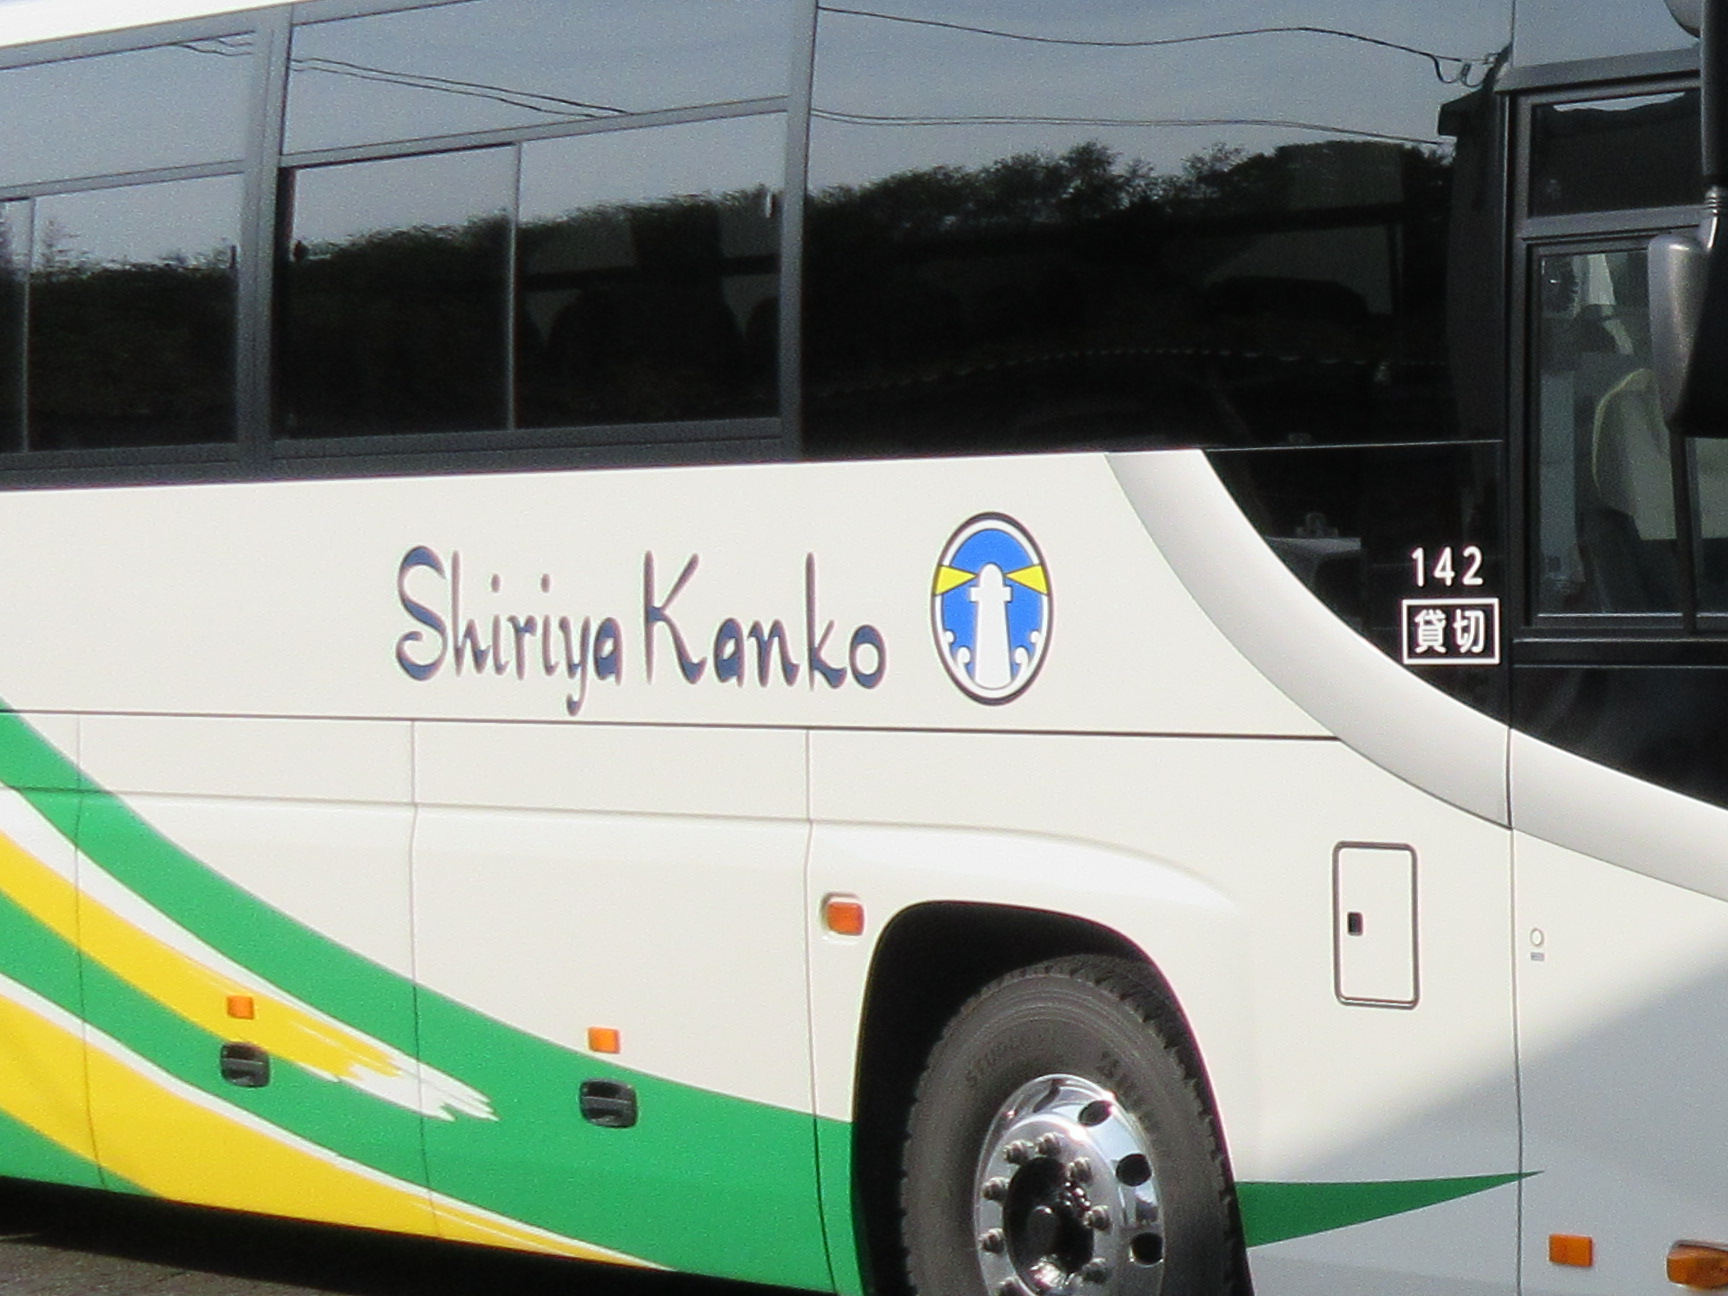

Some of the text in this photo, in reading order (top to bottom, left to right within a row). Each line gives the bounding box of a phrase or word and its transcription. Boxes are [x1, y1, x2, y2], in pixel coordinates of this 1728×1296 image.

[1411, 545, 1484, 587] 142
[395, 545, 886, 717] Shiriya Kanko
[1414, 608, 1486, 654] 貸切
